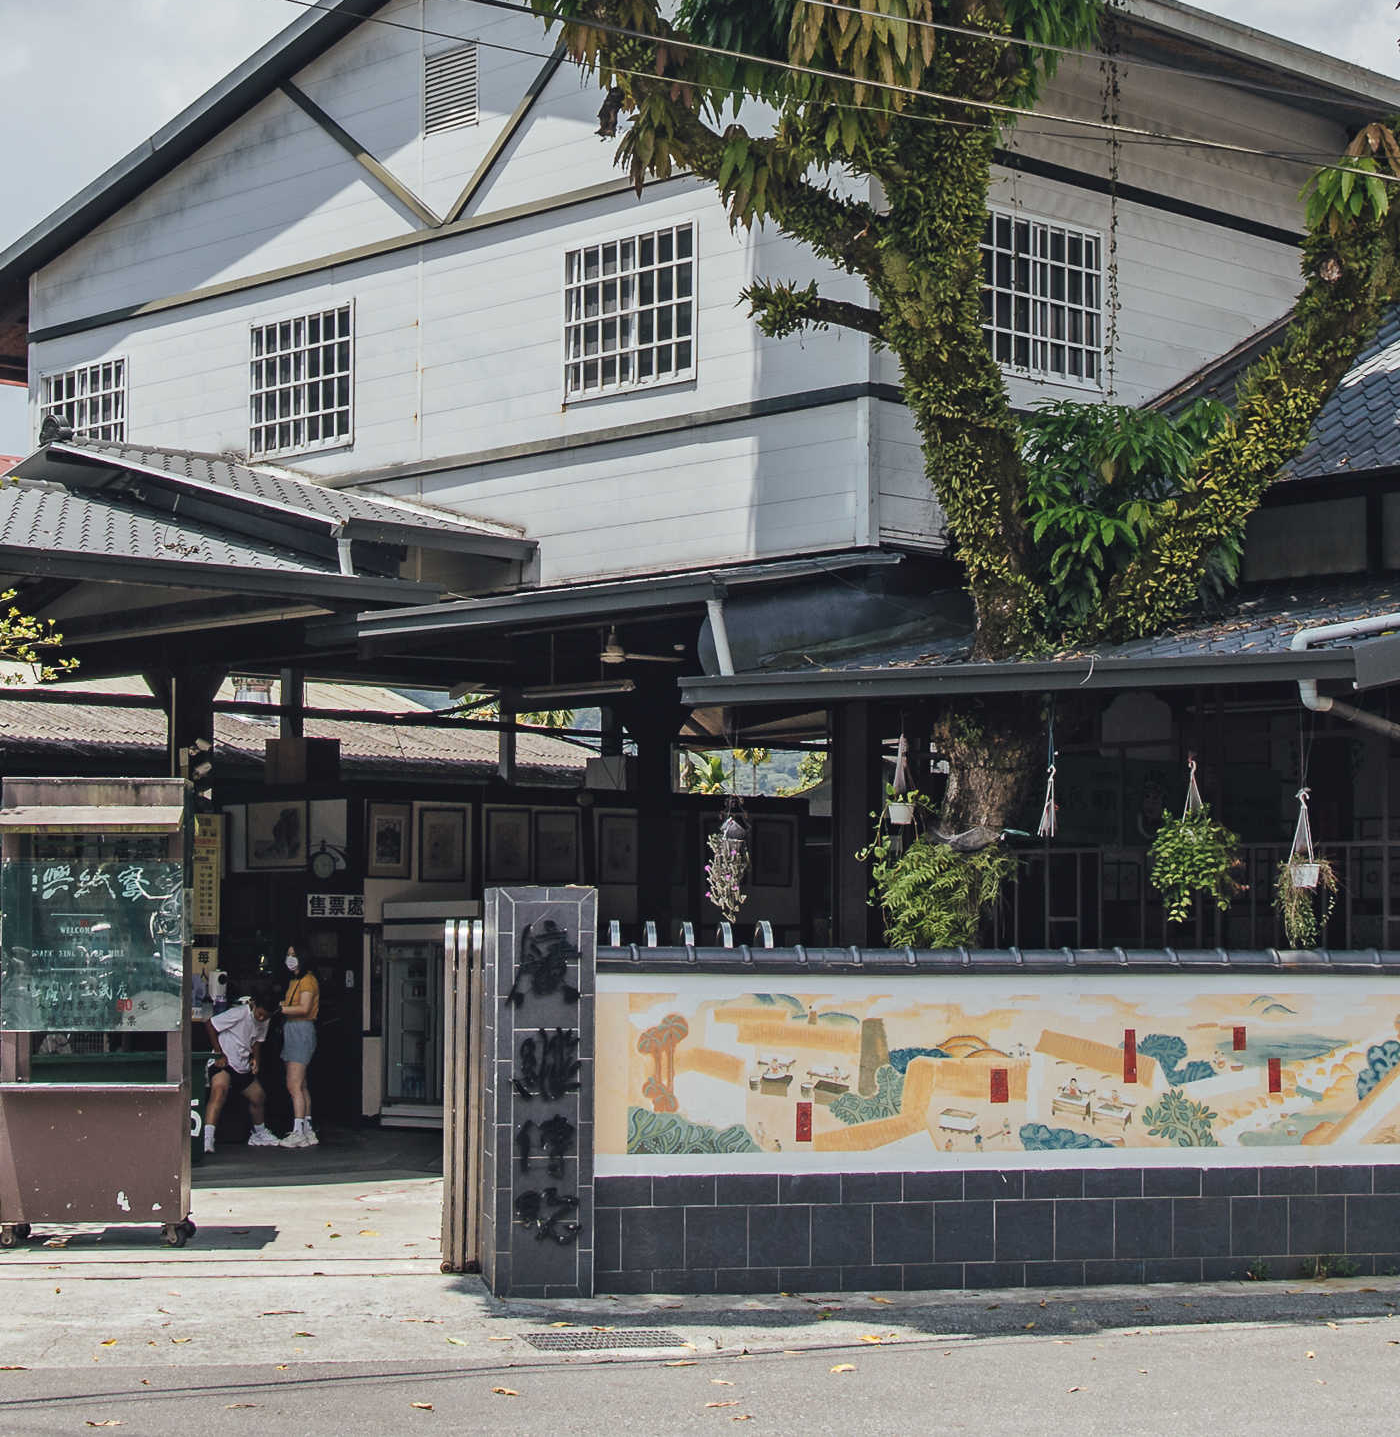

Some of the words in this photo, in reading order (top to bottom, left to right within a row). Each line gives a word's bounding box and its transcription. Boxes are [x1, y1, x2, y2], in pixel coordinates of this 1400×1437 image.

[32, 865, 150, 901] 興紙寮
[309, 895, 364, 916] 售票處
